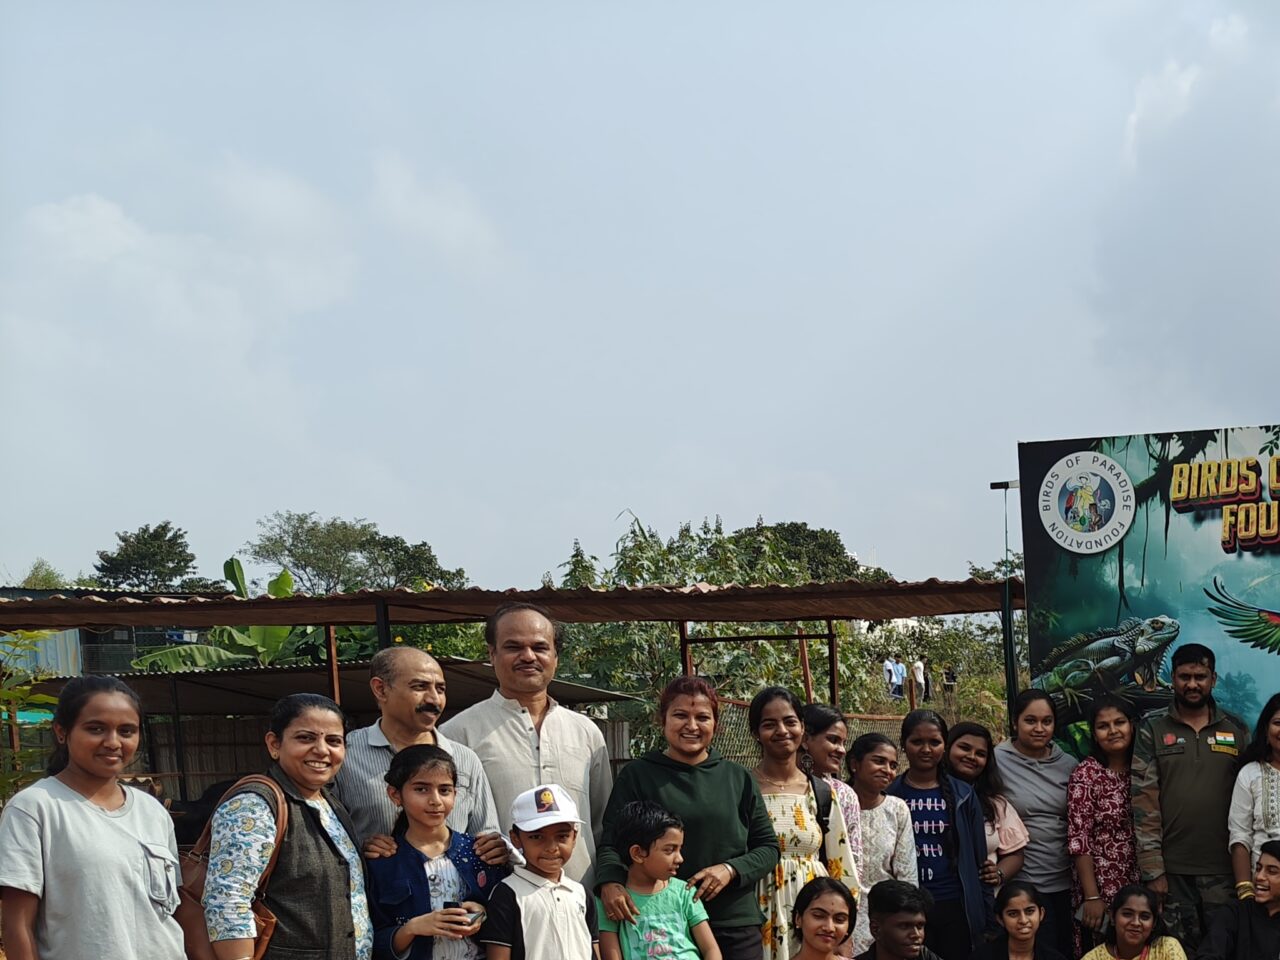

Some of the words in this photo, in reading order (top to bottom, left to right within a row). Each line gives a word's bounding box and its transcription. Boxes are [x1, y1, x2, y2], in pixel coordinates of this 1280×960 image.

[1066, 456, 1081, 469] OF
[1042, 471, 1060, 512] BIRDS
[1092, 455, 1132, 512] PARADISE
[1171, 457, 1260, 506] BIRDS
[1048, 521, 1126, 550] FOUNDATION
[905, 798, 947, 811] HOULD
[914, 820, 945, 835] OULD
